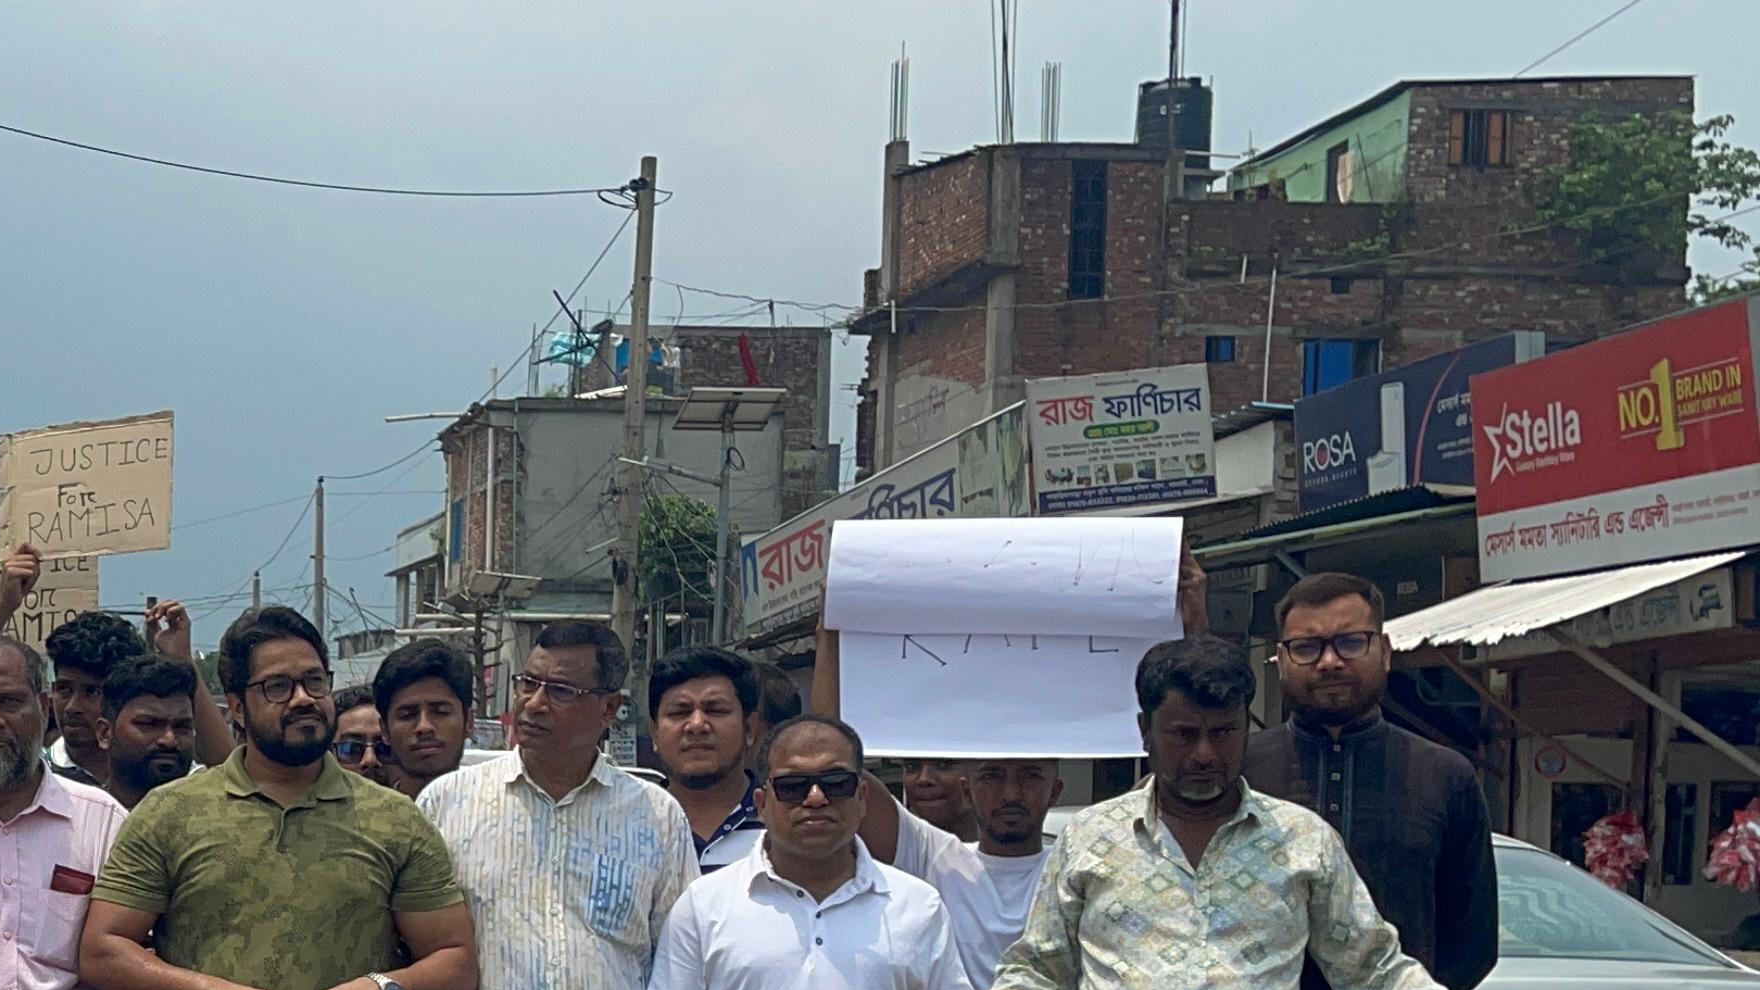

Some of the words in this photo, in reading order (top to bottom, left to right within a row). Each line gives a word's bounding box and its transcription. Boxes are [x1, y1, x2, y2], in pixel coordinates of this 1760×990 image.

[1676, 367, 1723, 400] BRAND
[1726, 364, 1742, 388] IN
[1037, 395, 1095, 426] রাজ
[1505, 402, 1582, 459] Stella
[30, 438, 168, 475] JUSTICE
[1303, 431, 1357, 475] ROSA
[28, 498, 156, 544] RAMISA
[1485, 522, 1516, 557] মেসার্স
[1518, 524, 1548, 550] মমতা
[1550, 508, 1602, 546] স্যানিটারি
[758, 519, 826, 591] রাজ
